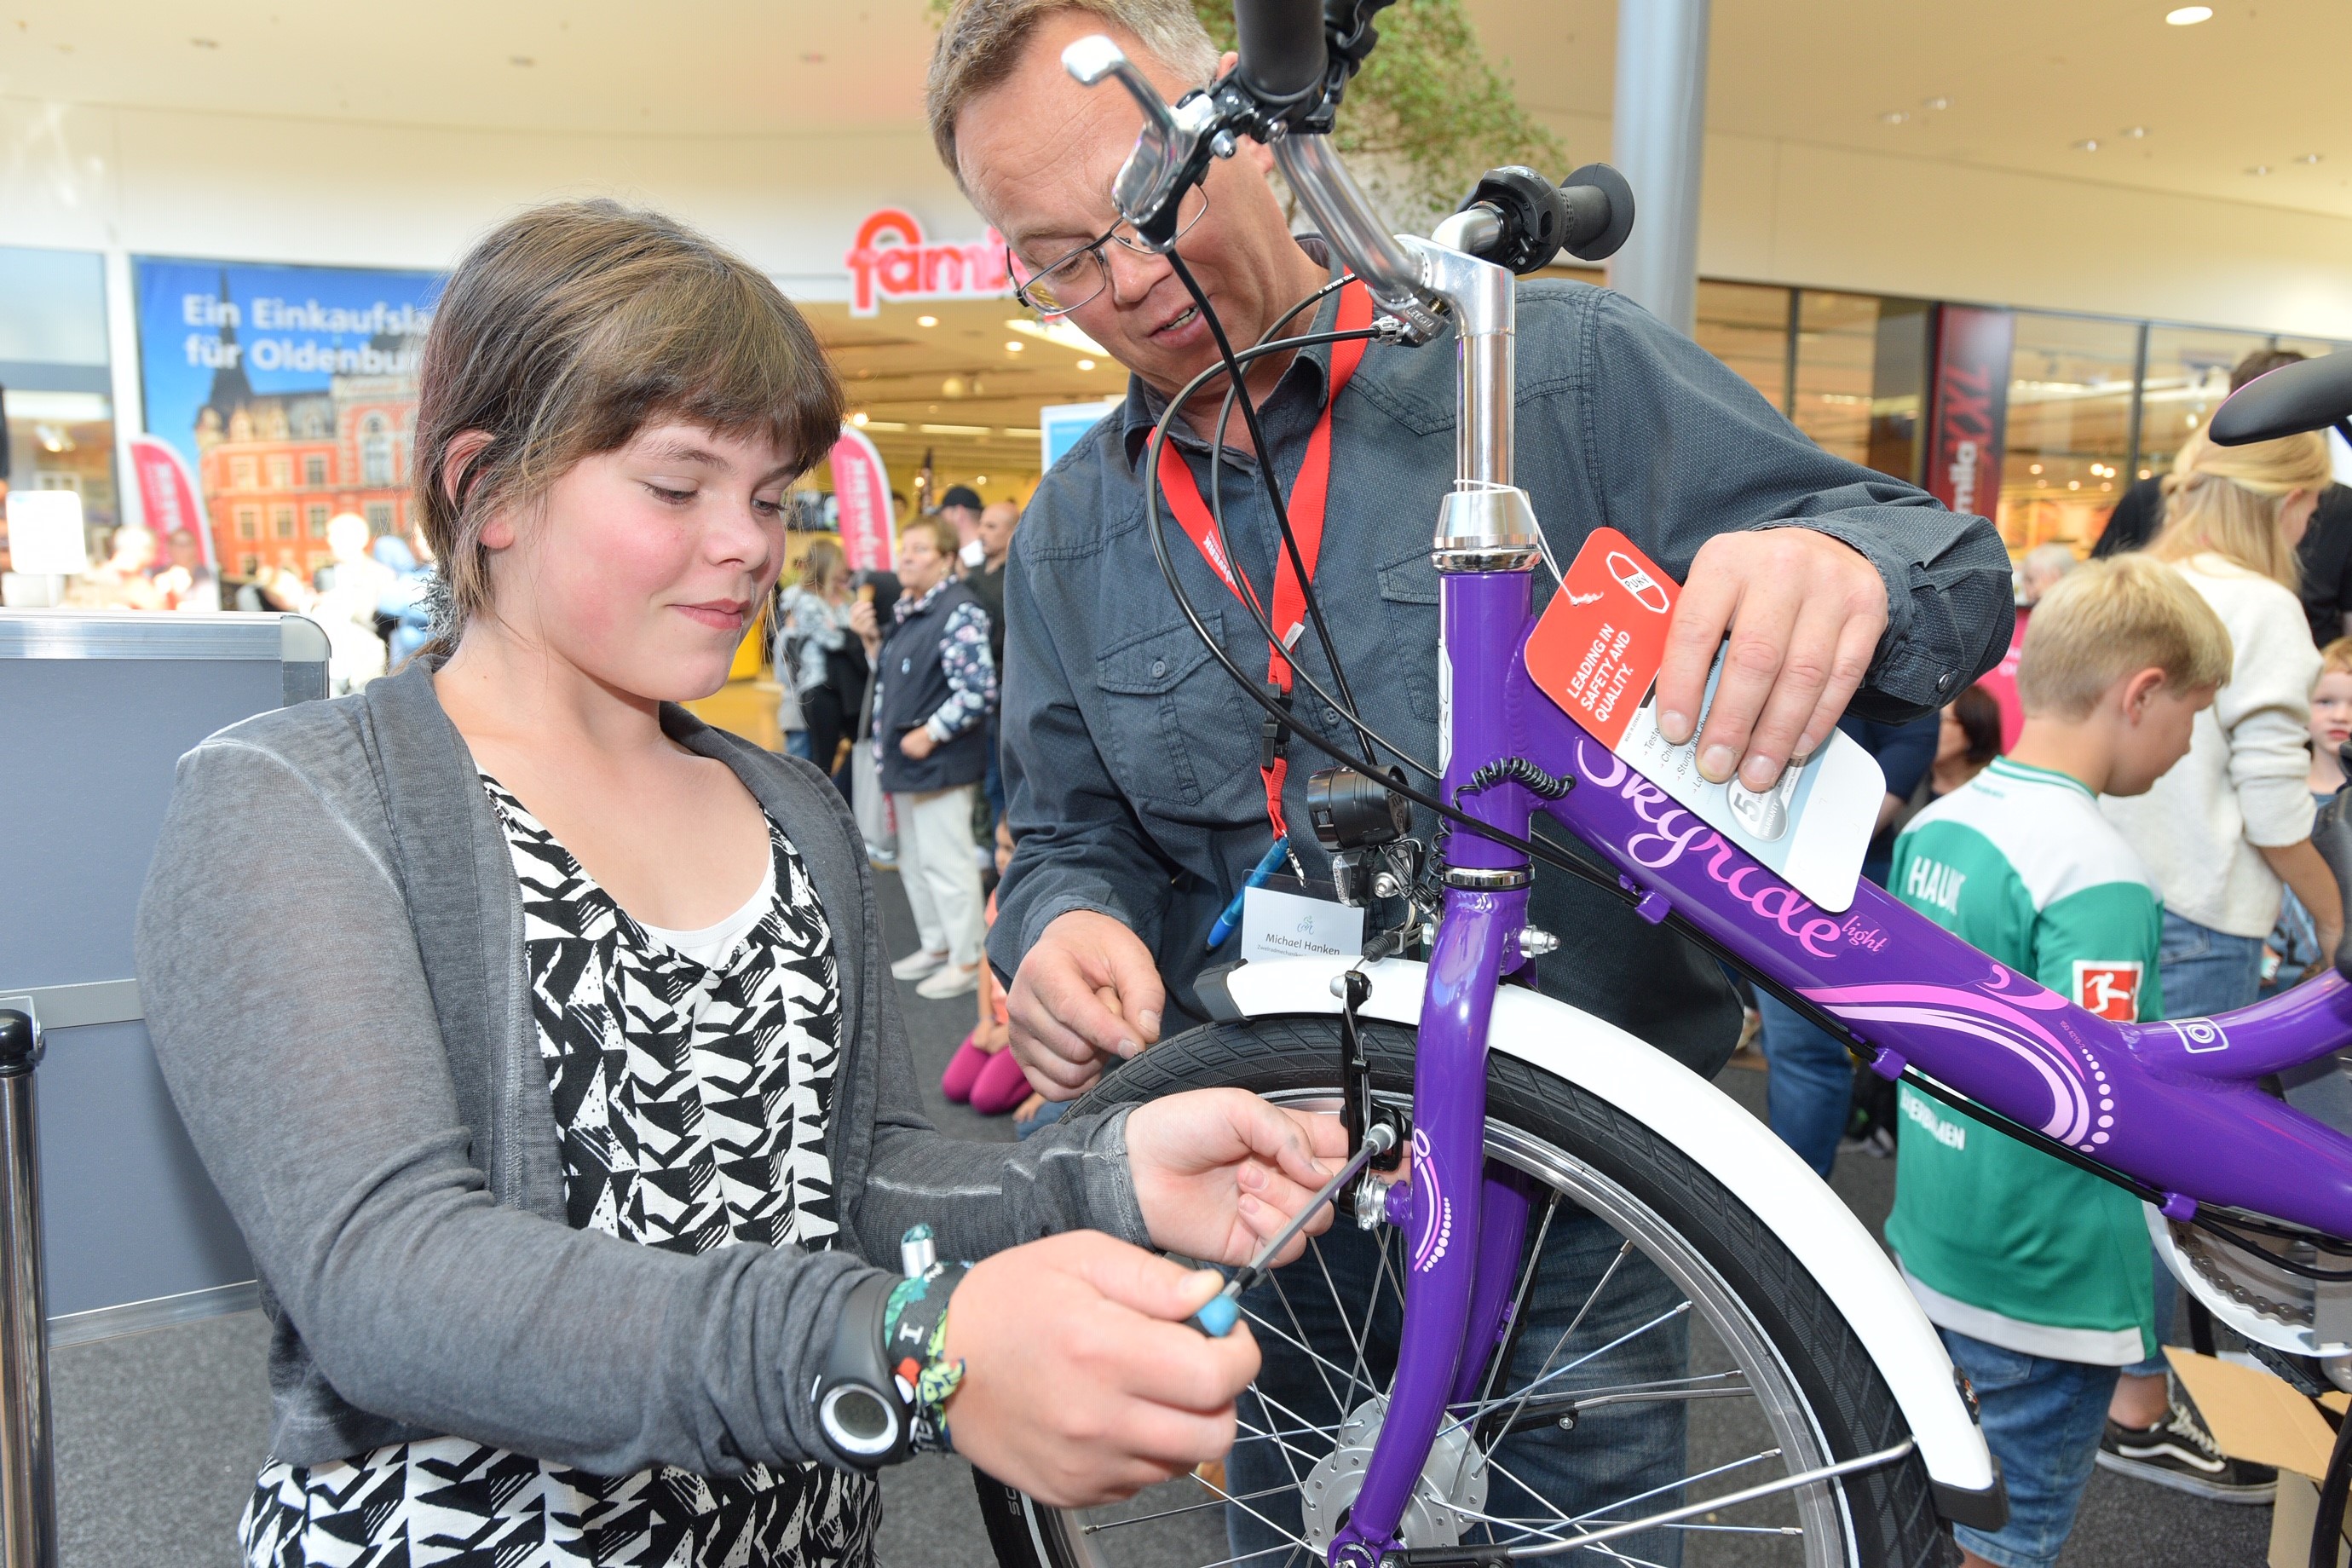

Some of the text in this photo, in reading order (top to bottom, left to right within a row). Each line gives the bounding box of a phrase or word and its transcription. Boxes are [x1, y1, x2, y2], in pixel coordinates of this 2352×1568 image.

[183, 294, 241, 328] Ein
[186, 334, 409, 375] für Oldenbu
[1944, 361, 1995, 468] XXL
[1624, 574, 1650, 590] PUKY
[1566, 622, 1615, 699] LEADING IN
[1580, 631, 1631, 711] SAFETY AND
[1594, 663, 1634, 723] QUALITY.
[1644, 726, 1660, 751] Teste
[1677, 747, 1696, 776] Sturdy
[1734, 793, 1761, 822] 5
[1265, 933, 1340, 956] Michael Hanken
[1842, 915, 1888, 953] light
[2060, 1020, 2085, 1050] ISO 4210-2
[1006, 1487, 1022, 1516] SC
